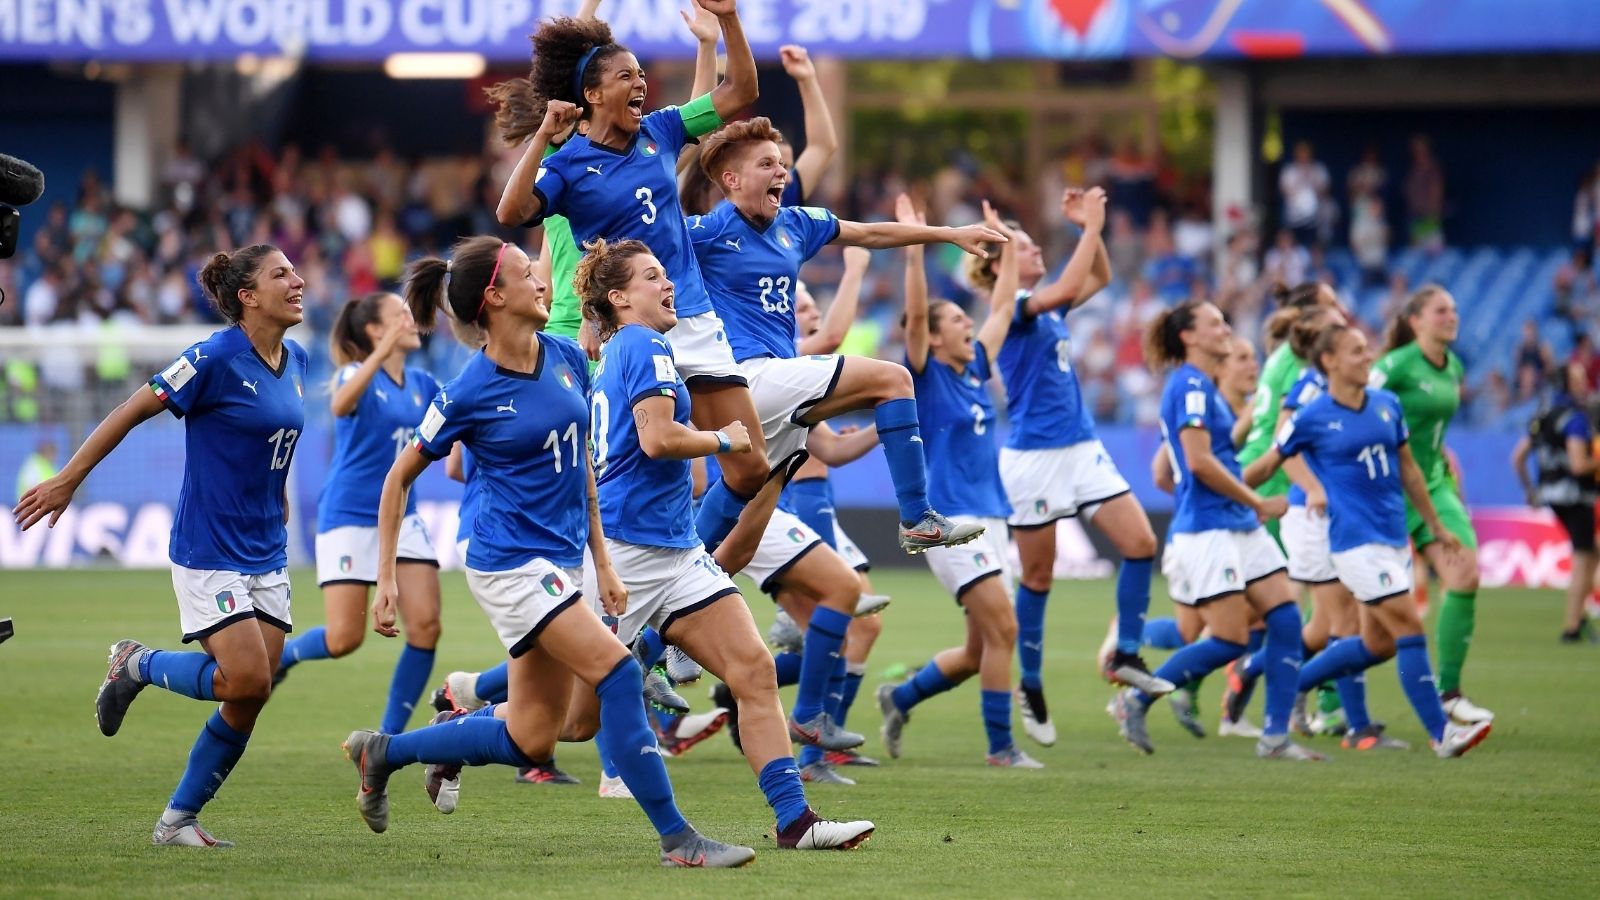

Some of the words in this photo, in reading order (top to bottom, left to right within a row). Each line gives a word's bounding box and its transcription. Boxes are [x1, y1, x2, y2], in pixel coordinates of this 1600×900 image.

[163, 0, 393, 45] WORLD
[402, 0, 533, 46] CUP
[789, 0, 926, 43] 2019
[635, 186, 657, 225] 3
[758, 275, 791, 314] 23
[971, 403, 986, 436] 2
[267, 428, 298, 471] 13
[542, 421, 578, 474] 11
[1357, 442, 1390, 480] 11
[0, 502, 174, 570] VISA
[1478, 538, 1575, 588] SNC
